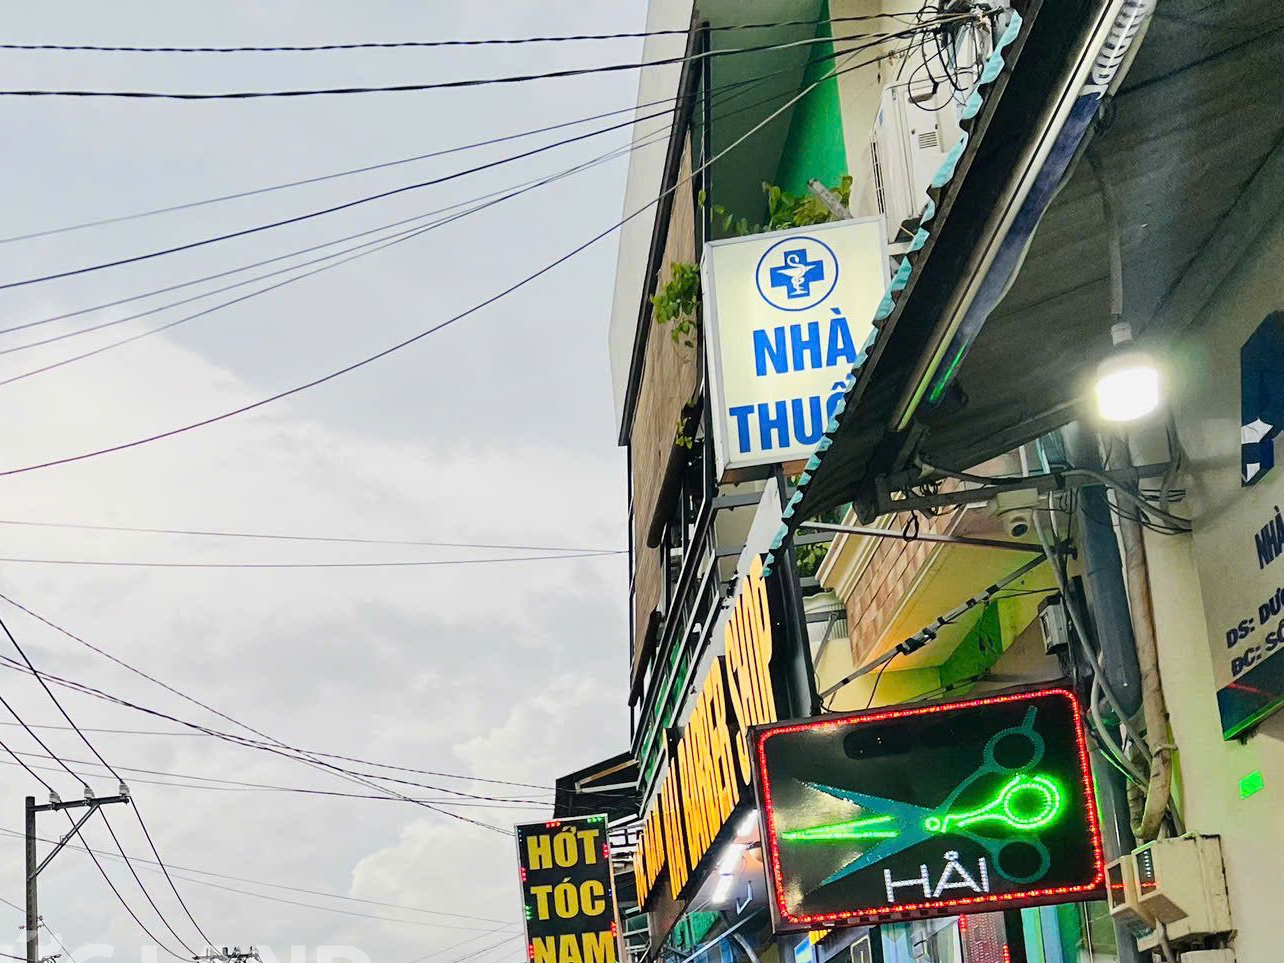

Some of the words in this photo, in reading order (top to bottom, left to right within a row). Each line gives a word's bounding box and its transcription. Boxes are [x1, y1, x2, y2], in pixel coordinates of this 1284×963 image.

[753, 308, 857, 376] NHÀ
[678, 656, 739, 871] BARBER
[725, 553, 777, 786] SHOP
[526, 826, 599, 870] HỚT
[530, 877, 606, 921] TÓC
[884, 850, 989, 902] HẢI
